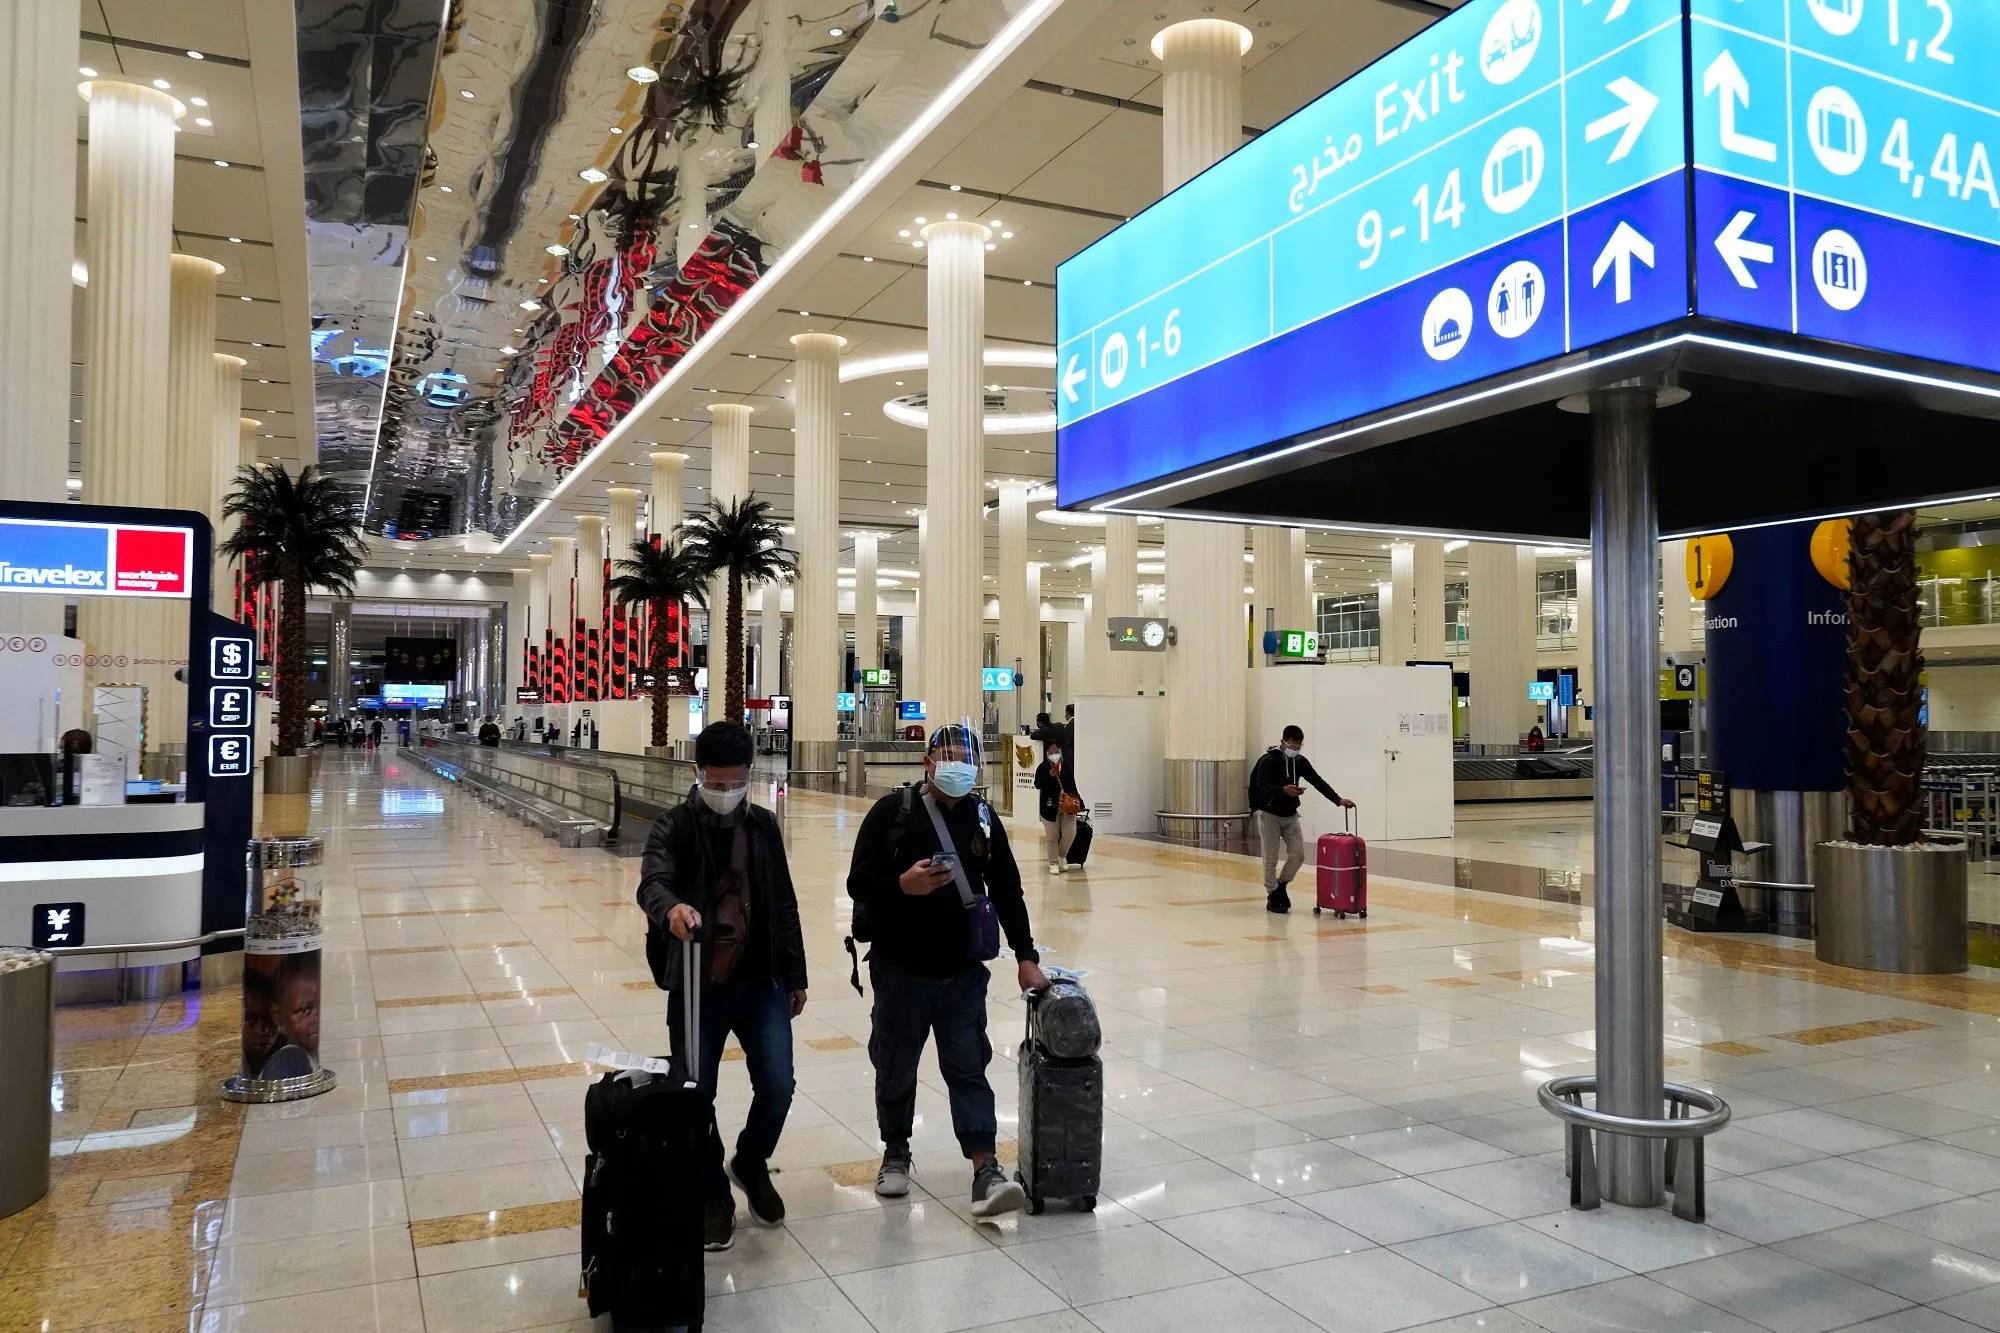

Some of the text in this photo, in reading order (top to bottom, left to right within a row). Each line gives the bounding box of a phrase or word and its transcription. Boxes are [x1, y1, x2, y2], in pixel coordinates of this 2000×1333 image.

[1375, 48, 1466, 147] Exit
[1288, 132, 1363, 213] مخرج
[1356, 167, 1466, 270] 9-14
[1136, 308, 1182, 369] 1-6
[117, 571, 179, 581] worldwide
[117, 579, 158, 590] money
[220, 763, 239, 771] EUR
[47, 933, 69, 942] JPY
